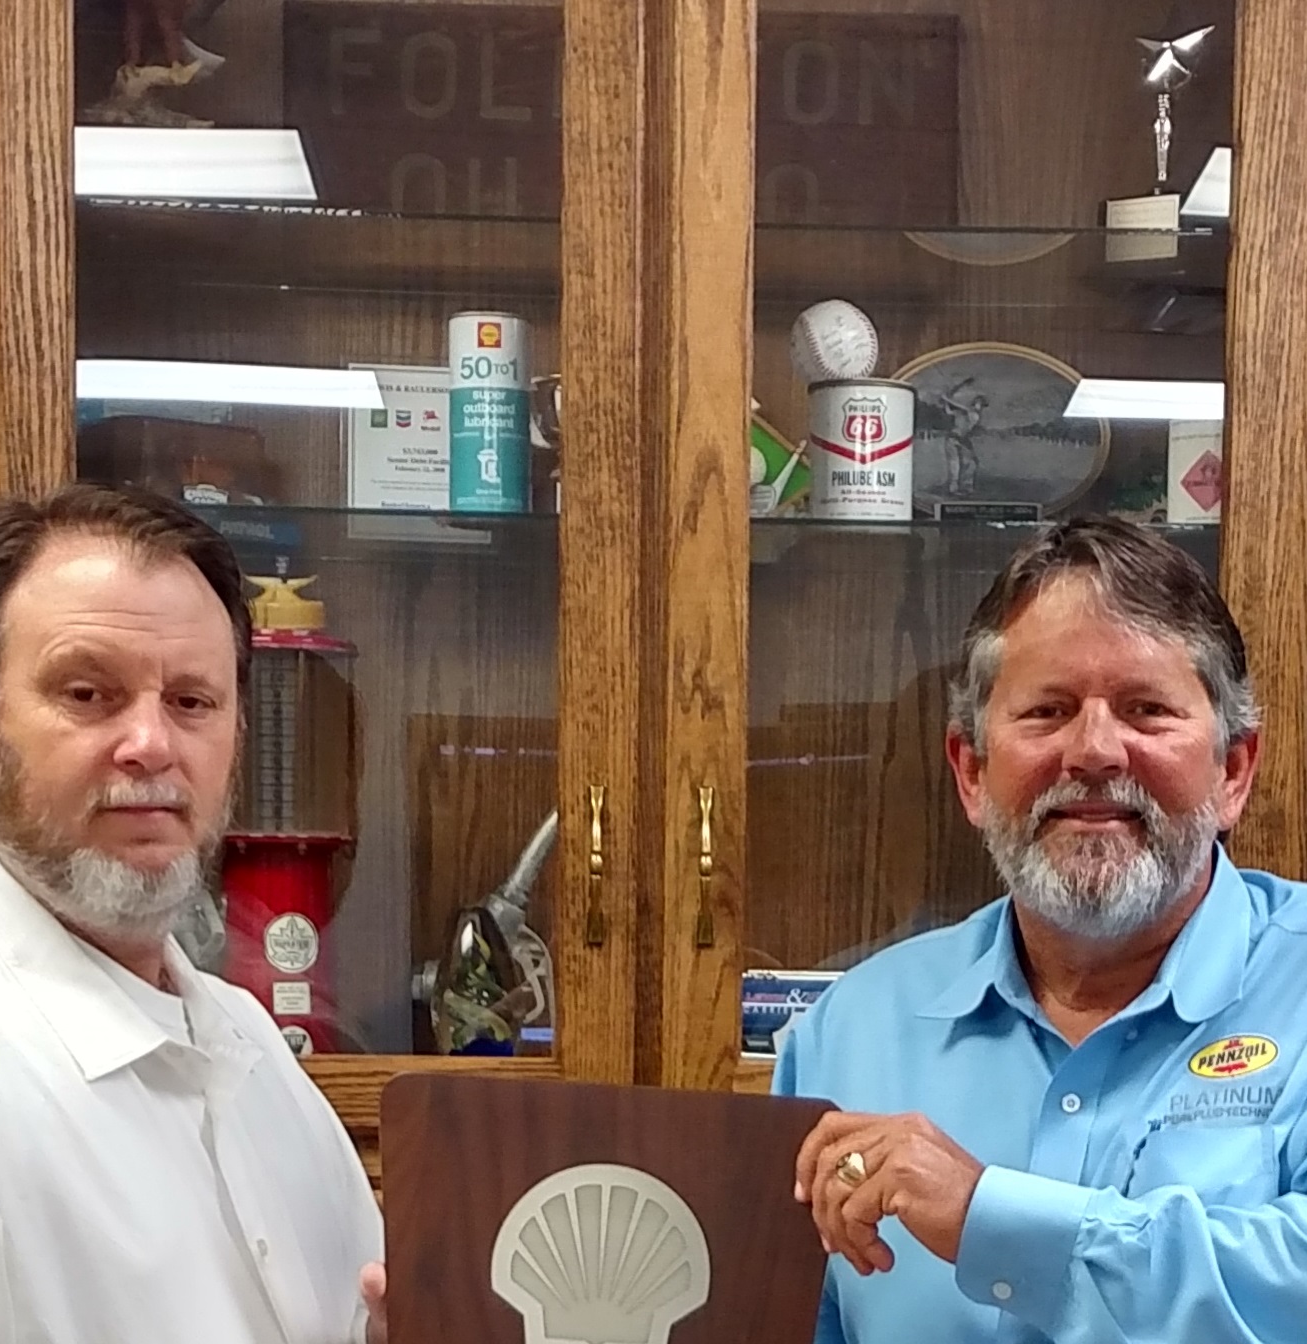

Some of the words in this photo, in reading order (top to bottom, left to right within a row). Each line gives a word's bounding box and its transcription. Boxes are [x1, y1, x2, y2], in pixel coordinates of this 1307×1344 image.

[460, 356, 492, 380] 50
[494, 364, 509, 375] TO
[508, 357, 519, 382] 1
[404, 381, 450, 394] RAULERSO
[473, 389, 507, 403] super
[462, 403, 515, 415] outboard
[848, 403, 882, 413] PHILLIPS
[464, 416, 514, 429] lubricant
[850, 416, 878, 436] 66
[831, 470, 873, 487] PHILUBE
[875, 471, 896, 487] ASM
[1197, 1042, 1268, 1070] PENNZOIL
[1169, 1086, 1286, 1113] PLATINUM
